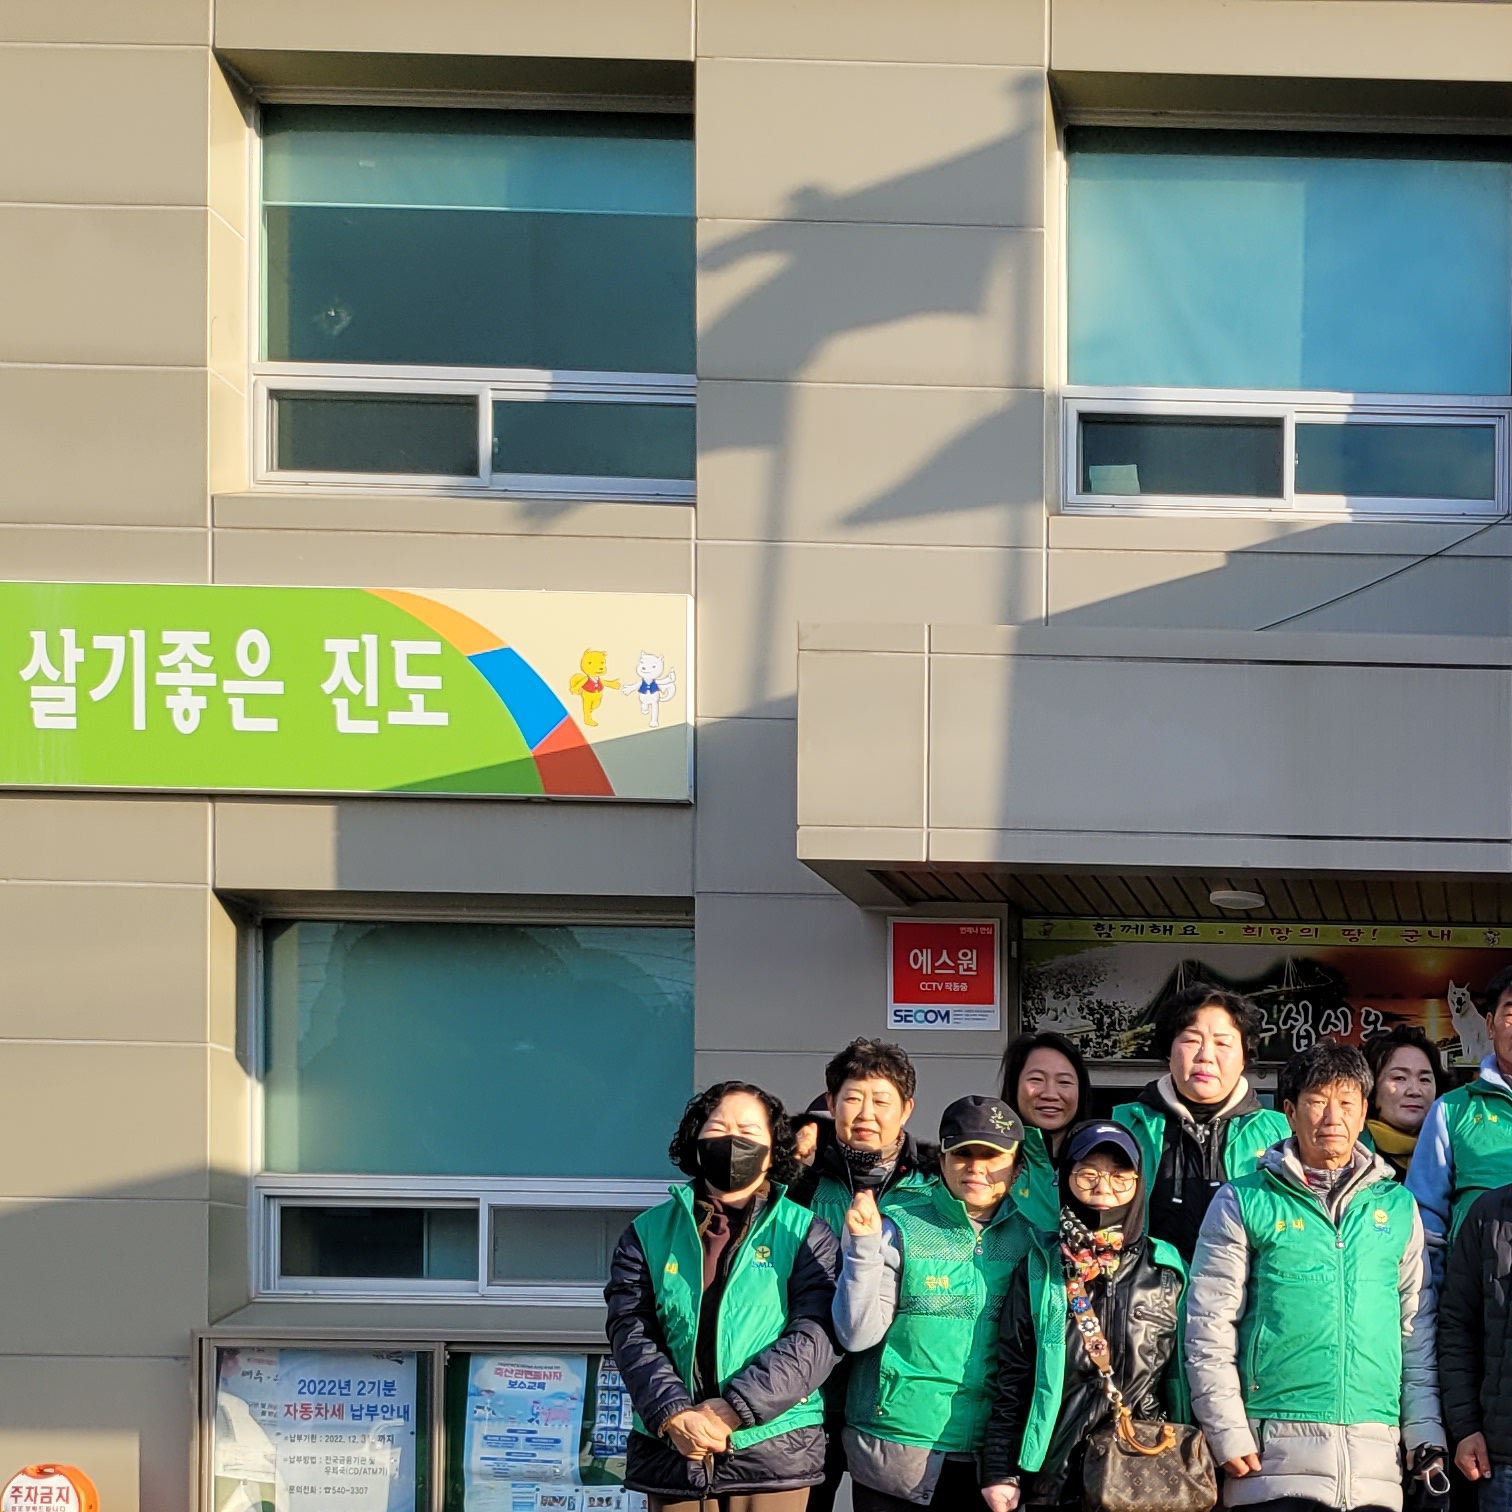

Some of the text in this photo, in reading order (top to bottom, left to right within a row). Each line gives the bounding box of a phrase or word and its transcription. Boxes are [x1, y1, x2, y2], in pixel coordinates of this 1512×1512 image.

[19, 628, 449, 735] 살기좋은 진도
[1093, 922, 1452, 943] 함께해요 희망의 땅! 군내
[909, 948, 978, 976] 에스원
[919, 981, 943, 991] CCTV
[893, 1008, 951, 1025] SECOM
[297, 1379, 397, 1397] 2022년 2기분
[284, 1402, 345, 1421] 자동차세
[350, 1403, 411, 1422] 납부안내
